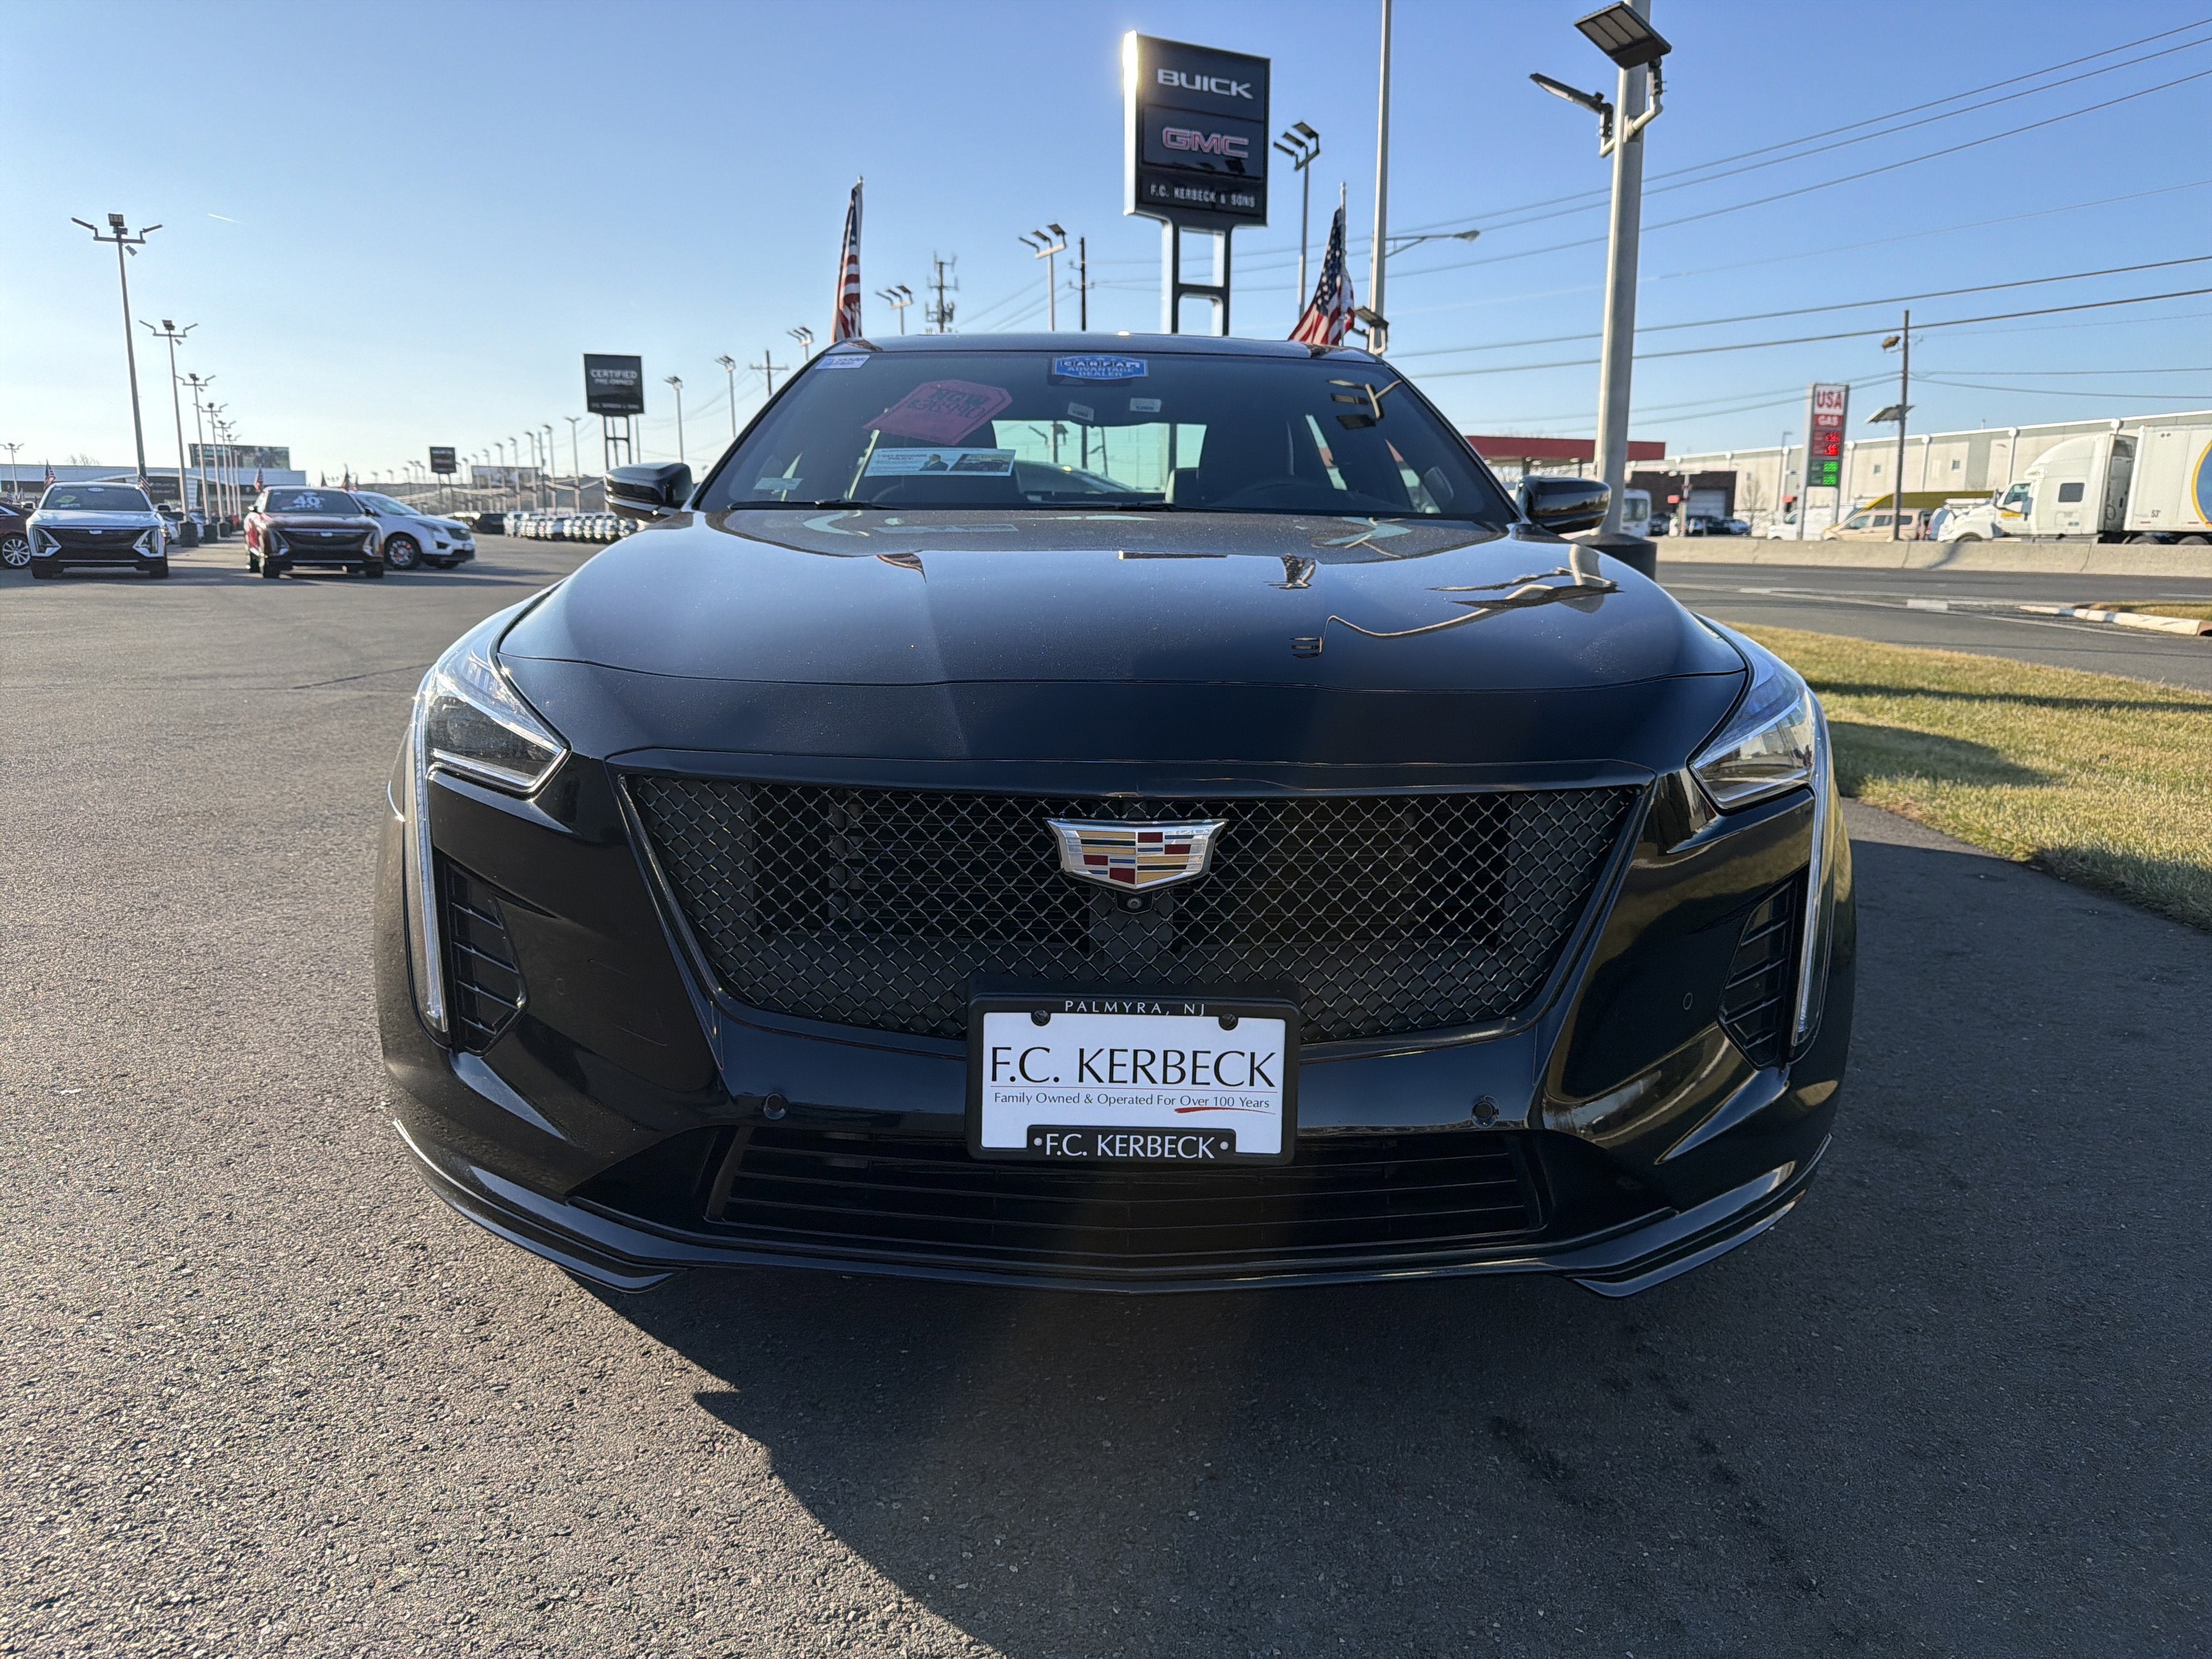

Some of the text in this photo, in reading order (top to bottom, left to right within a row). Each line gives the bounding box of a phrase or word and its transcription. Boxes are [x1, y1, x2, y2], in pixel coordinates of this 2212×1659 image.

[1157, 68, 1254, 100] BUICK
[1162, 126, 1249, 159] GMC
[1150, 183, 1170, 198] F.C.
[1174, 187, 1216, 202] KERBECK
[1231, 193, 1256, 208] SONS
[1816, 390, 1843, 409] USA
[1065, 1000, 1205, 1017] PALMYRA, NJ
[991, 1046, 1277, 1088] F.C. KERBECK
[994, 1092, 1270, 1108] Family Owned & Operated For Over 100 Years
[1046, 1133, 1215, 1159] F.C. KERBECK
